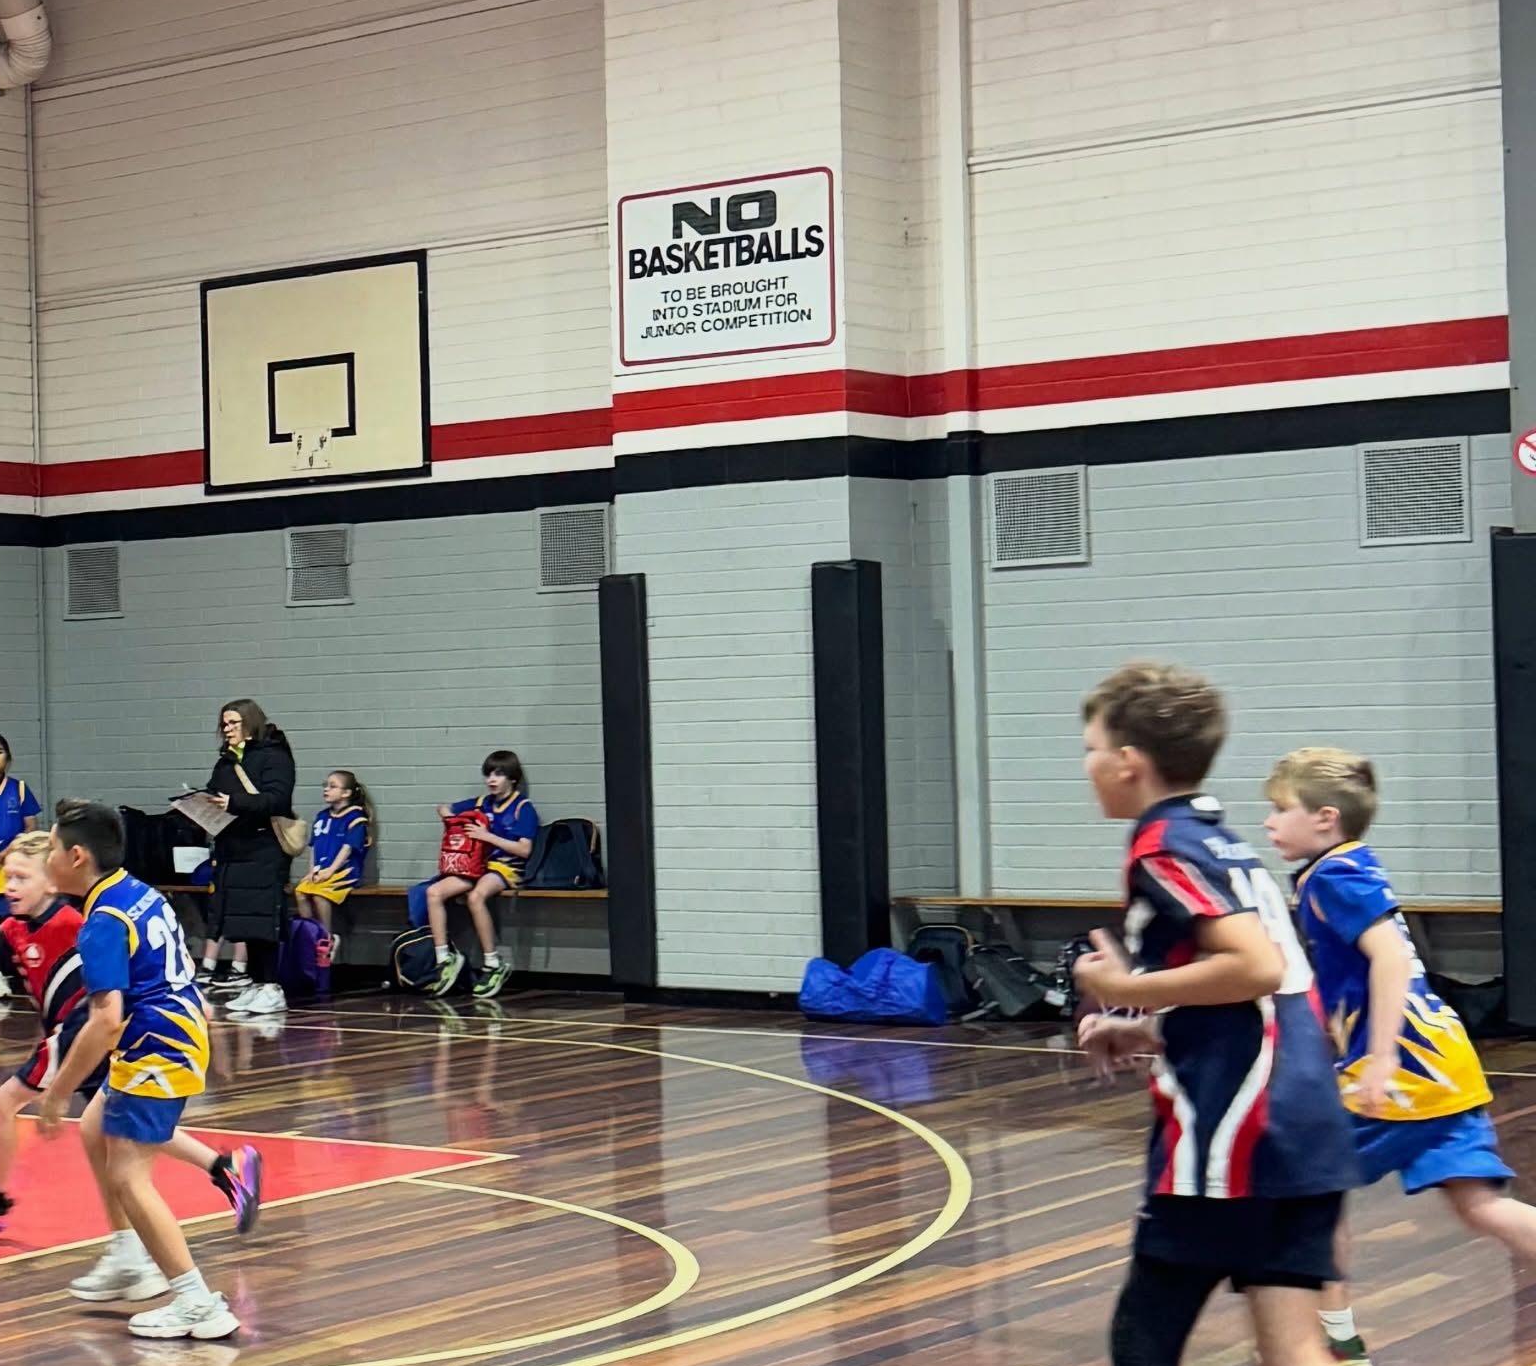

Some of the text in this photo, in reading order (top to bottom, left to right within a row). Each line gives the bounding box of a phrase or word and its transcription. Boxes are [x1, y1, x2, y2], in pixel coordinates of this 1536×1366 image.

[672, 190, 777, 239] NO
[629, 225, 825, 280] BASKETBALLS
[661, 276, 789, 304] TO BE BROUGHT
[652, 293, 798, 322] INTO STADIUM FOR
[641, 308, 812, 339] JUNIOR COMPETITION
